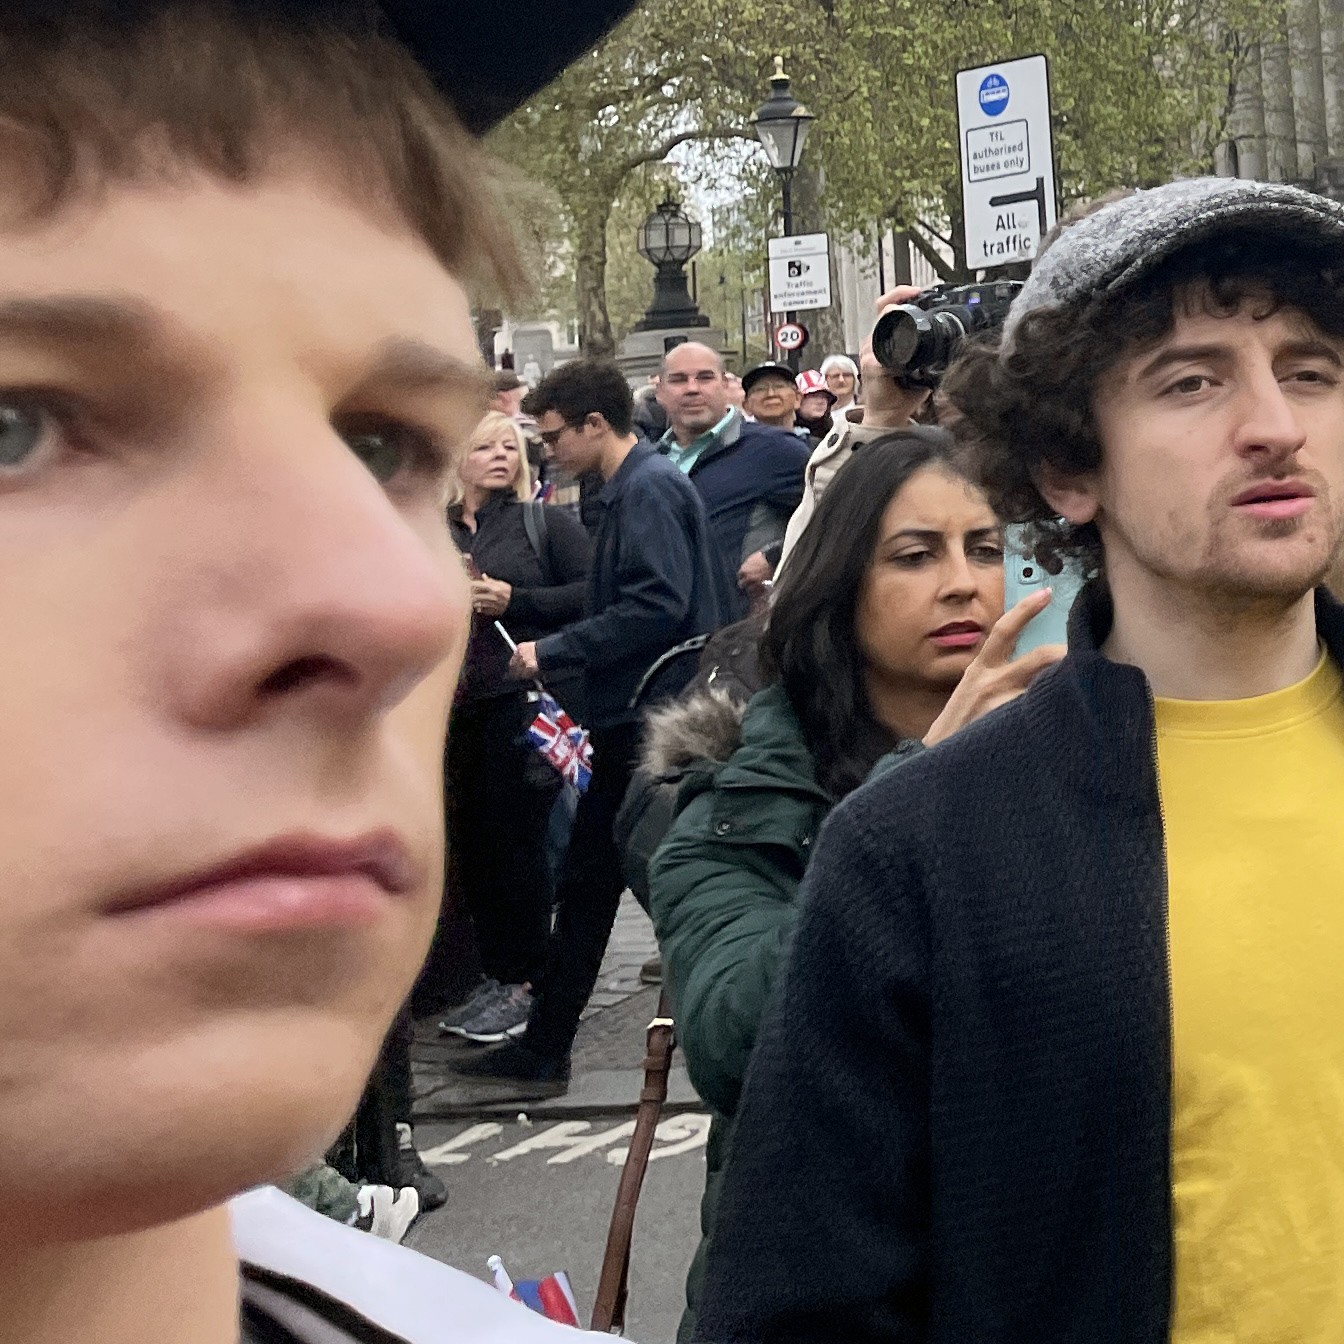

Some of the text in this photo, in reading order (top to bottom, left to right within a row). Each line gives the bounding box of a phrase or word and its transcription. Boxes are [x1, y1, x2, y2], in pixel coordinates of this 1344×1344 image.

[989, 131, 1005, 142] TfL
[972, 141, 1024, 160] authorised
[973, 158, 1025, 174] buses only
[995, 212, 1017, 232] All
[983, 234, 1032, 258] traffic
[780, 330, 800, 343] 20
